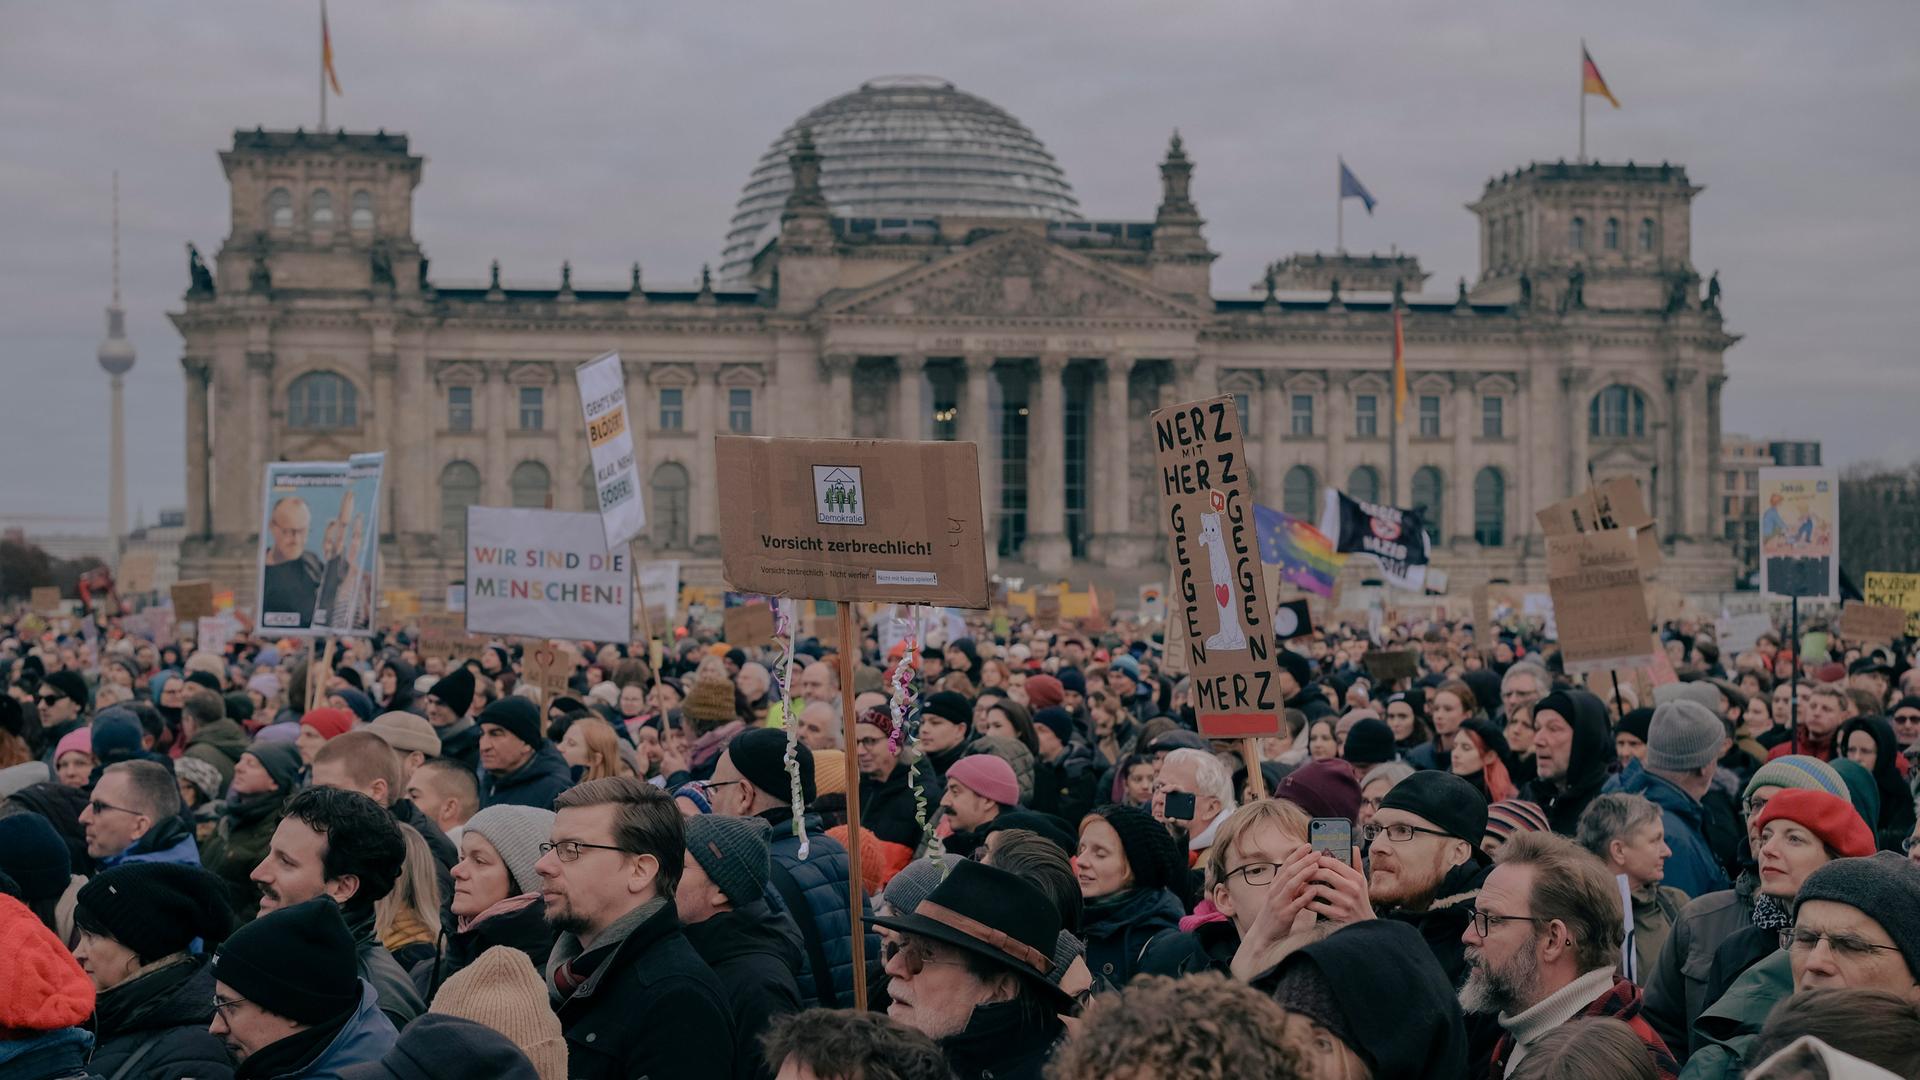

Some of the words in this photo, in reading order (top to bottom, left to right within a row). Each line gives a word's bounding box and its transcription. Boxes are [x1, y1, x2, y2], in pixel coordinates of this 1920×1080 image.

[1156, 403, 1232, 452] NERZ
[1182, 444, 1203, 458] MIT
[1164, 453, 1238, 496] HERZ
[819, 513, 863, 523] Demokratie
[761, 535, 823, 551] Vorsicht
[828, 540, 933, 556] zerbrechlich!
[474, 547, 517, 567] WIR
[526, 550, 580, 569] SIND
[590, 553, 623, 572] DIE
[760, 565, 785, 575] Vorsicht
[787, 567, 823, 577] zerbrechlich
[1172, 504, 1206, 666] GEGEN
[1227, 490, 1267, 661] GEGEN
[475, 578, 622, 605] MENSCHEN!
[1197, 671, 1275, 710] MERZ
